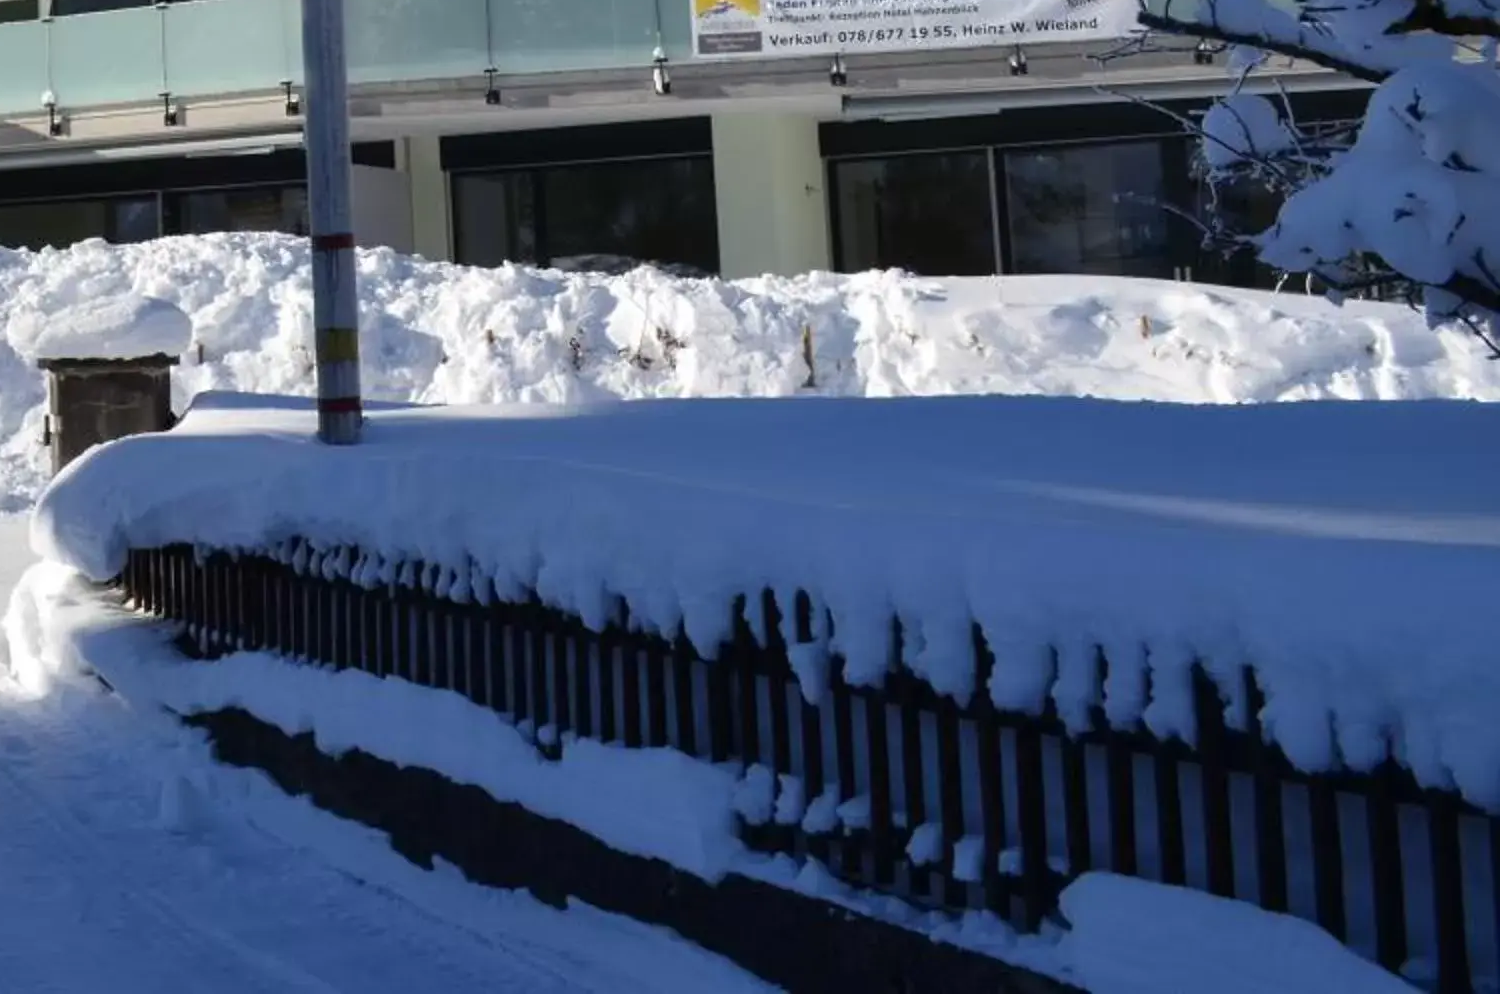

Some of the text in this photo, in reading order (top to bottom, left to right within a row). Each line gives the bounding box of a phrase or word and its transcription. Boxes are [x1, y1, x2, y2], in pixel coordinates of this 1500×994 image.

[769, 31, 833, 47] Verkauf:
[908, 27, 929, 39] 19
[962, 23, 1006, 37] Heinz
[1010, 21, 1031, 34] W.
[1035, 17, 1098, 32] Wieland
